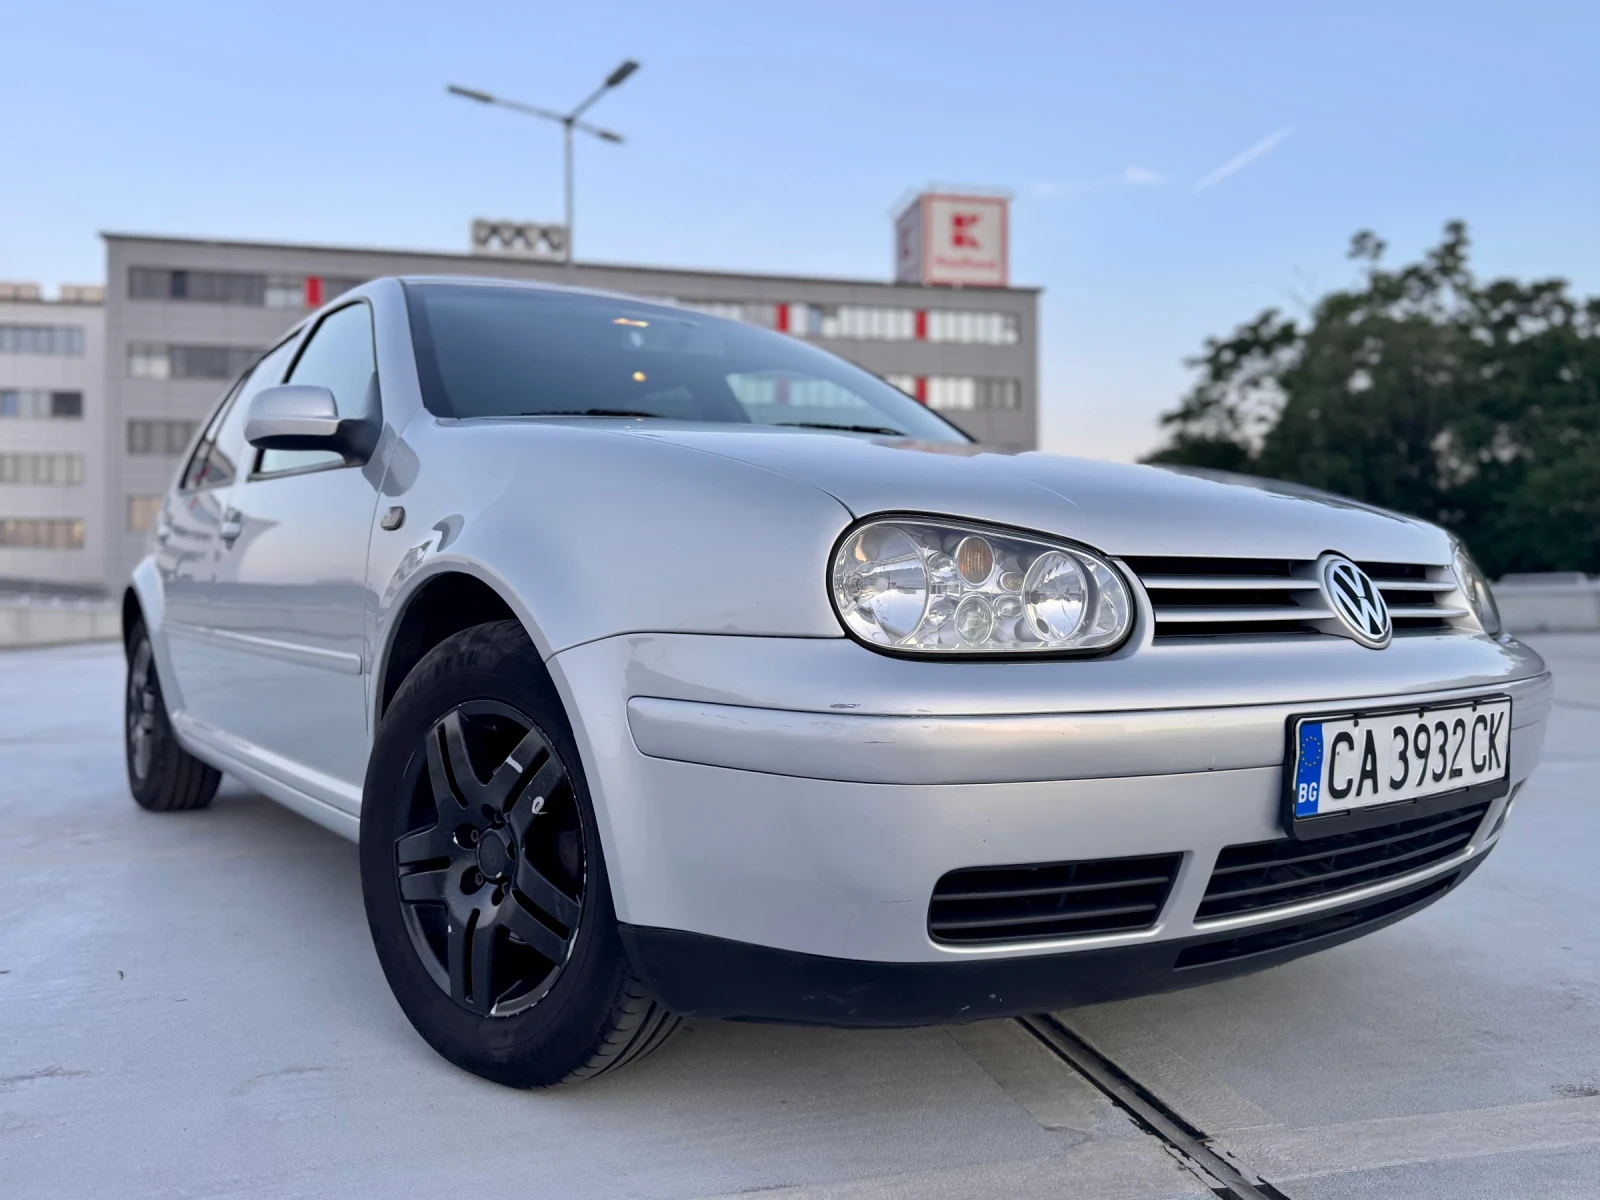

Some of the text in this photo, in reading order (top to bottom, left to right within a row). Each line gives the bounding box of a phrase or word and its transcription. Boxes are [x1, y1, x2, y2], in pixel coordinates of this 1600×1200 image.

[951, 214, 980, 248] K
[1330, 563, 1387, 637] VW
[1328, 711, 1504, 799] CA 3932 CK
[1298, 782, 1318, 802] BG
